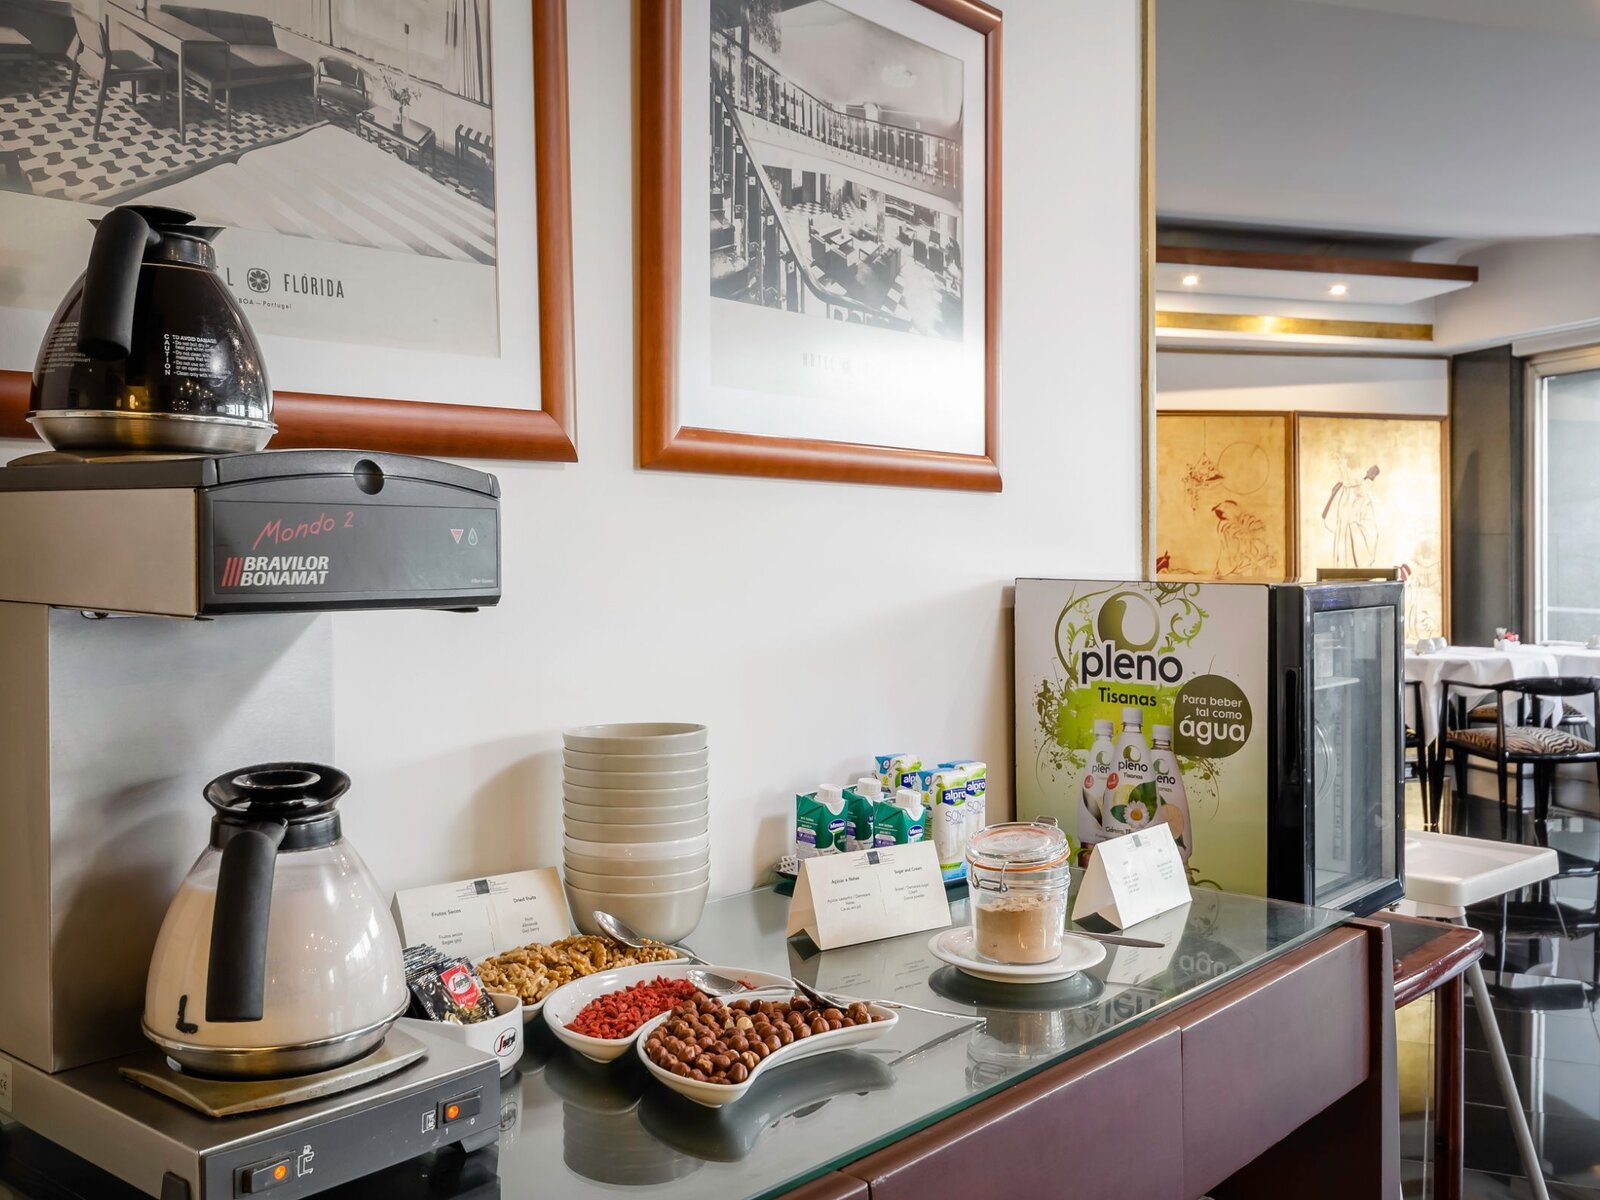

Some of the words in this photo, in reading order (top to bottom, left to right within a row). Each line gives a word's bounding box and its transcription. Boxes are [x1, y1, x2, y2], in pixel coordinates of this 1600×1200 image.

[284, 273, 344, 298] FLÓRIDA
[252, 513, 335, 550] Mondo
[343, 511, 354, 529] 2
[243, 556, 329, 571] BRAVILOR
[240, 571, 328, 587] BONAMAT
[1082, 644, 1183, 684] pleno
[1098, 687, 1157, 707] Tisanas
[1182, 694, 1207, 706] Para
[1210, 695, 1242, 708] beber
[1196, 707, 1209, 717] tal
[1212, 709, 1242, 720] como
[1179, 715, 1245, 745] água
[1092, 764, 1110, 774] plen
[1118, 760, 1148, 772] pleno
[903, 774, 917, 785] alp
[967, 781, 985, 792] alpro
[1156, 775, 1176, 784] eno
[944, 790, 966, 801] alpro
